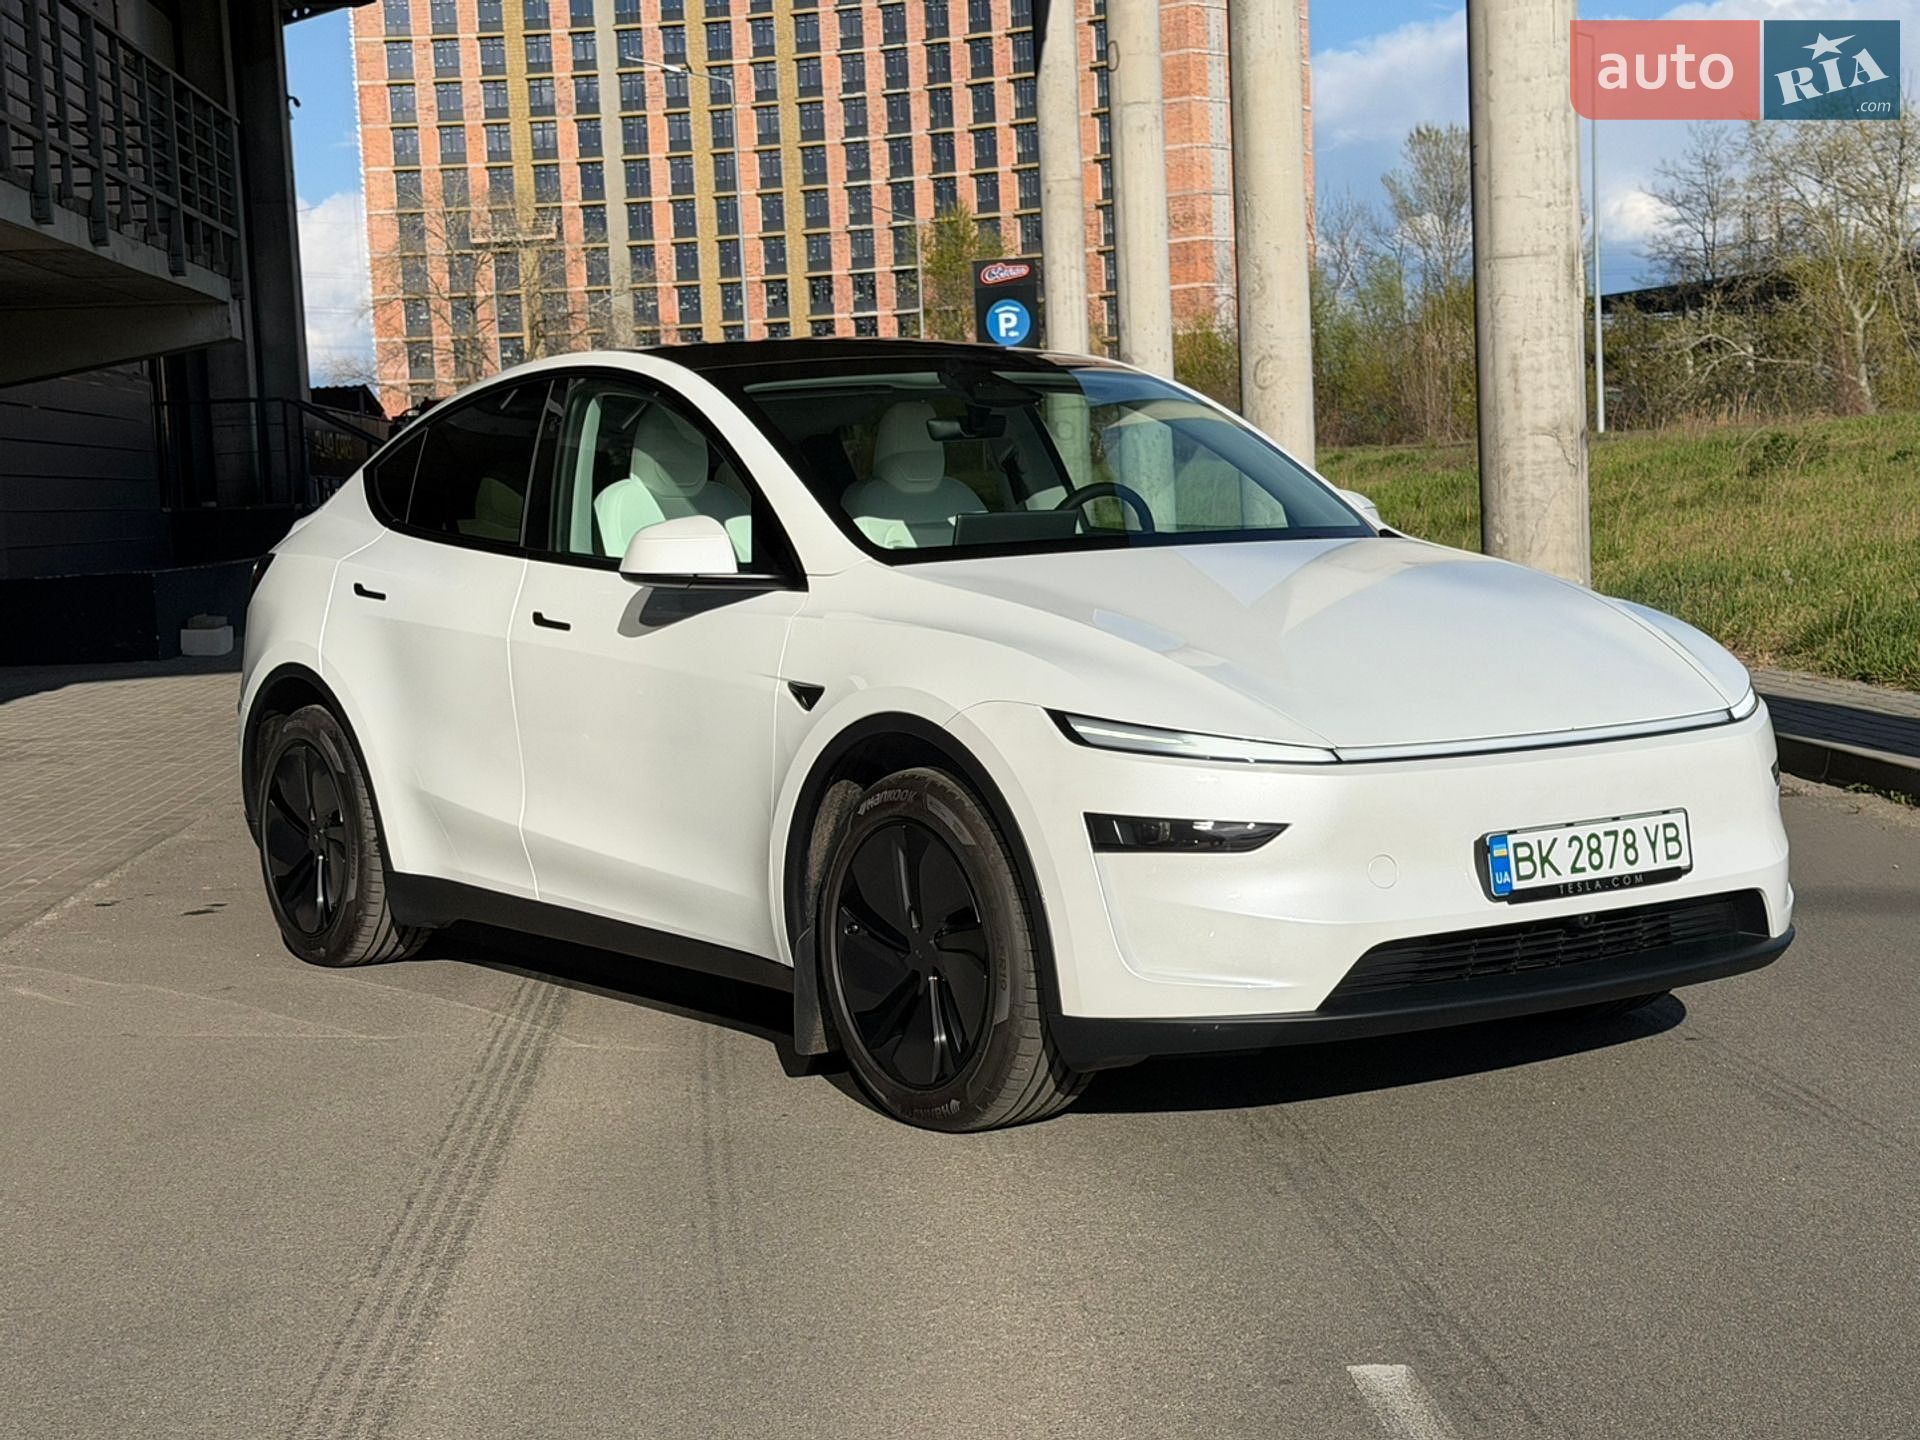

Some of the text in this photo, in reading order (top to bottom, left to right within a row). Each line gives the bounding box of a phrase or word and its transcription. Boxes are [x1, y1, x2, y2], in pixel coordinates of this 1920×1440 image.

[998, 313, 1018, 337] P
[1513, 822, 1684, 882] BK 2878 YB
[1495, 871, 1511, 885] UA
[1559, 875, 1645, 894] TESLA.COM
